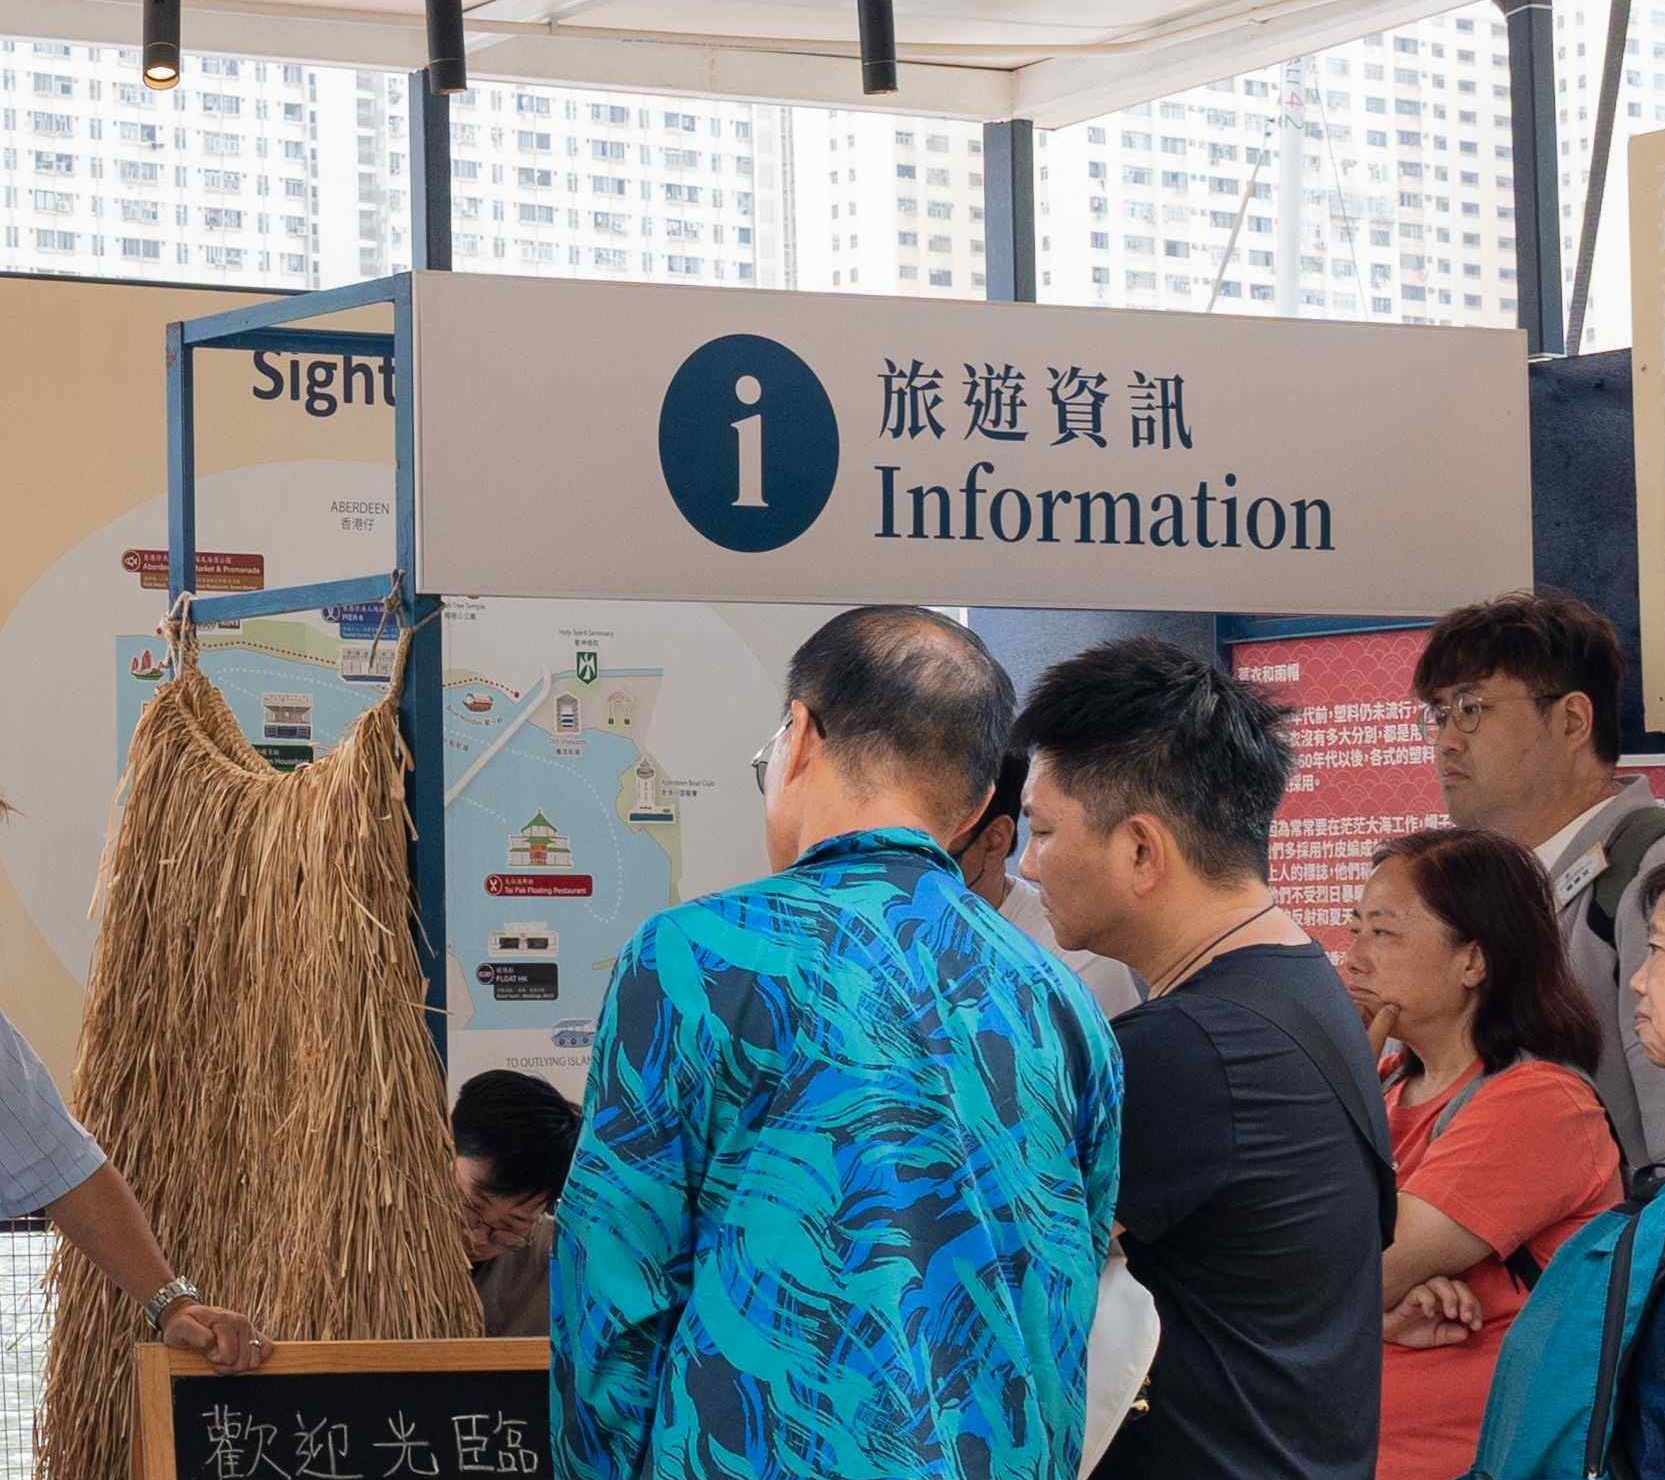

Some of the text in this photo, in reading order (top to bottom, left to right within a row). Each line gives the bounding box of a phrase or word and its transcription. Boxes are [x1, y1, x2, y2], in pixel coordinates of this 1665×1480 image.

[877, 357, 1193, 450] 旅遊資訊
[330, 500, 390, 515] ABERDEEN
[874, 460, 1336, 551] Information
[341, 518, 375, 532] 香港仔
[527, 887, 553, 896] Floating
[553, 887, 587, 895] Restaurant
[520, 1056, 565, 1067] OUTLYING
